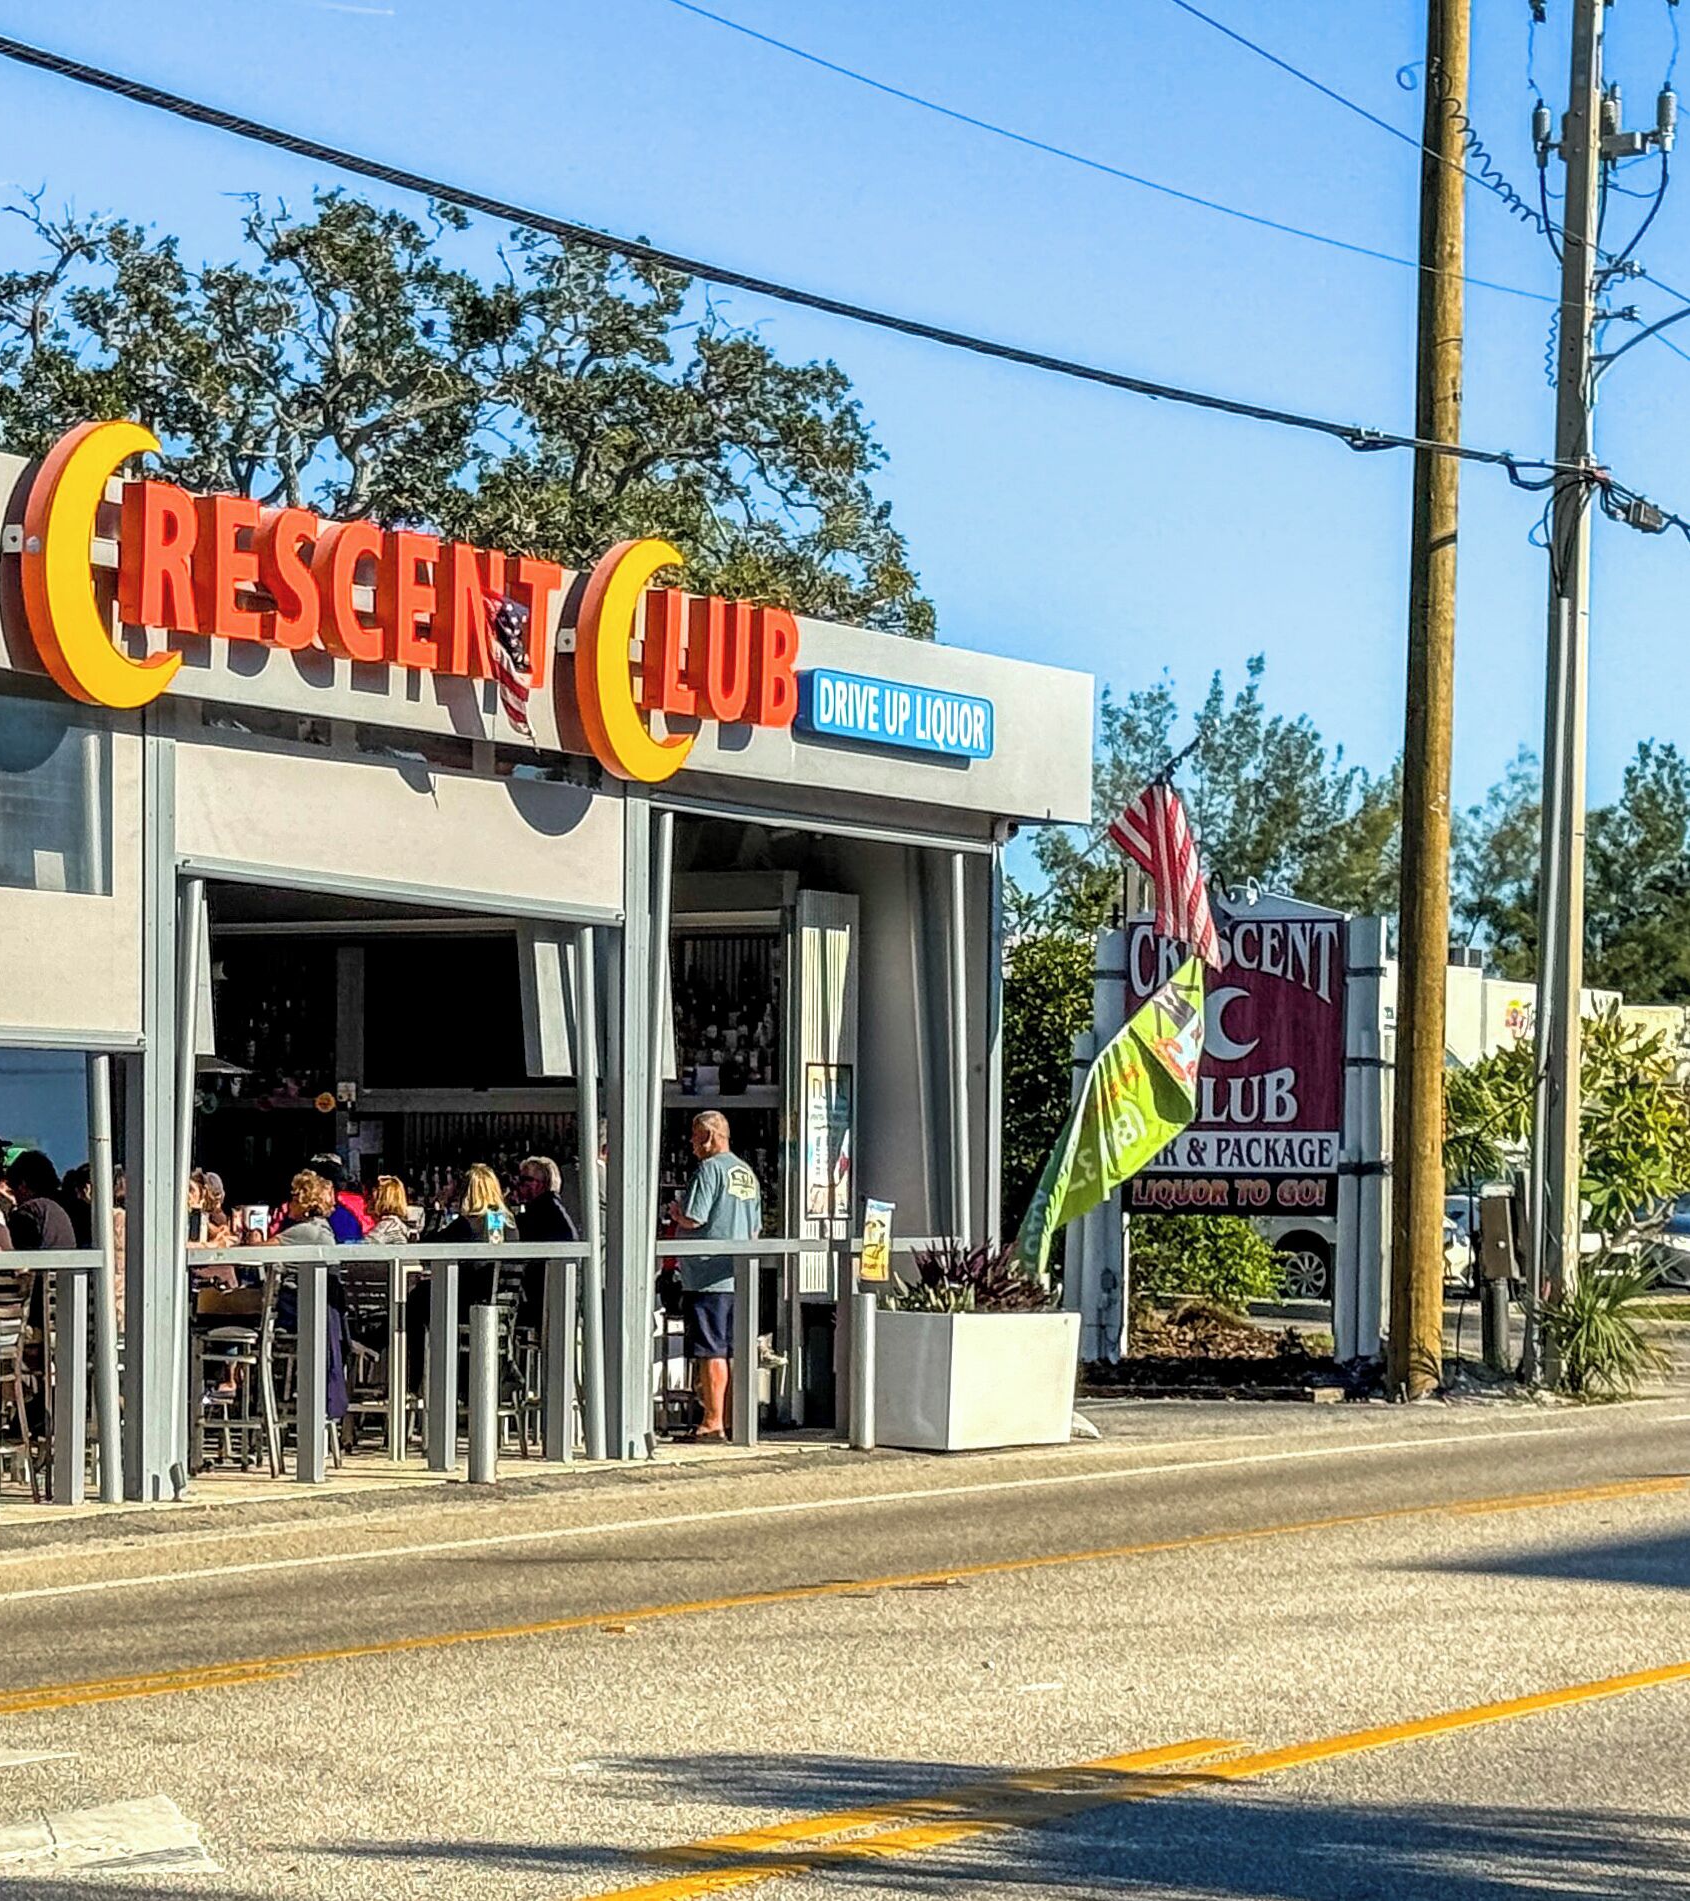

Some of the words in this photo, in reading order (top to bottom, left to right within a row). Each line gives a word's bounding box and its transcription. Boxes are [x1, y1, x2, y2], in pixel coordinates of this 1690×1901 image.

[819, 677, 880, 732] DRIVE
[884, 688, 910, 736] UP
[915, 692, 986, 751] LIQUOR
[1198, 1067, 1299, 1124] LUB
[1186, 1137, 1208, 1167] &
[1214, 1137, 1334, 1169] PACKAGE
[1131, 1178, 1230, 1210] LIQUOR
[1234, 1178, 1271, 1207] TO
[1276, 1178, 1328, 1207] GO!
